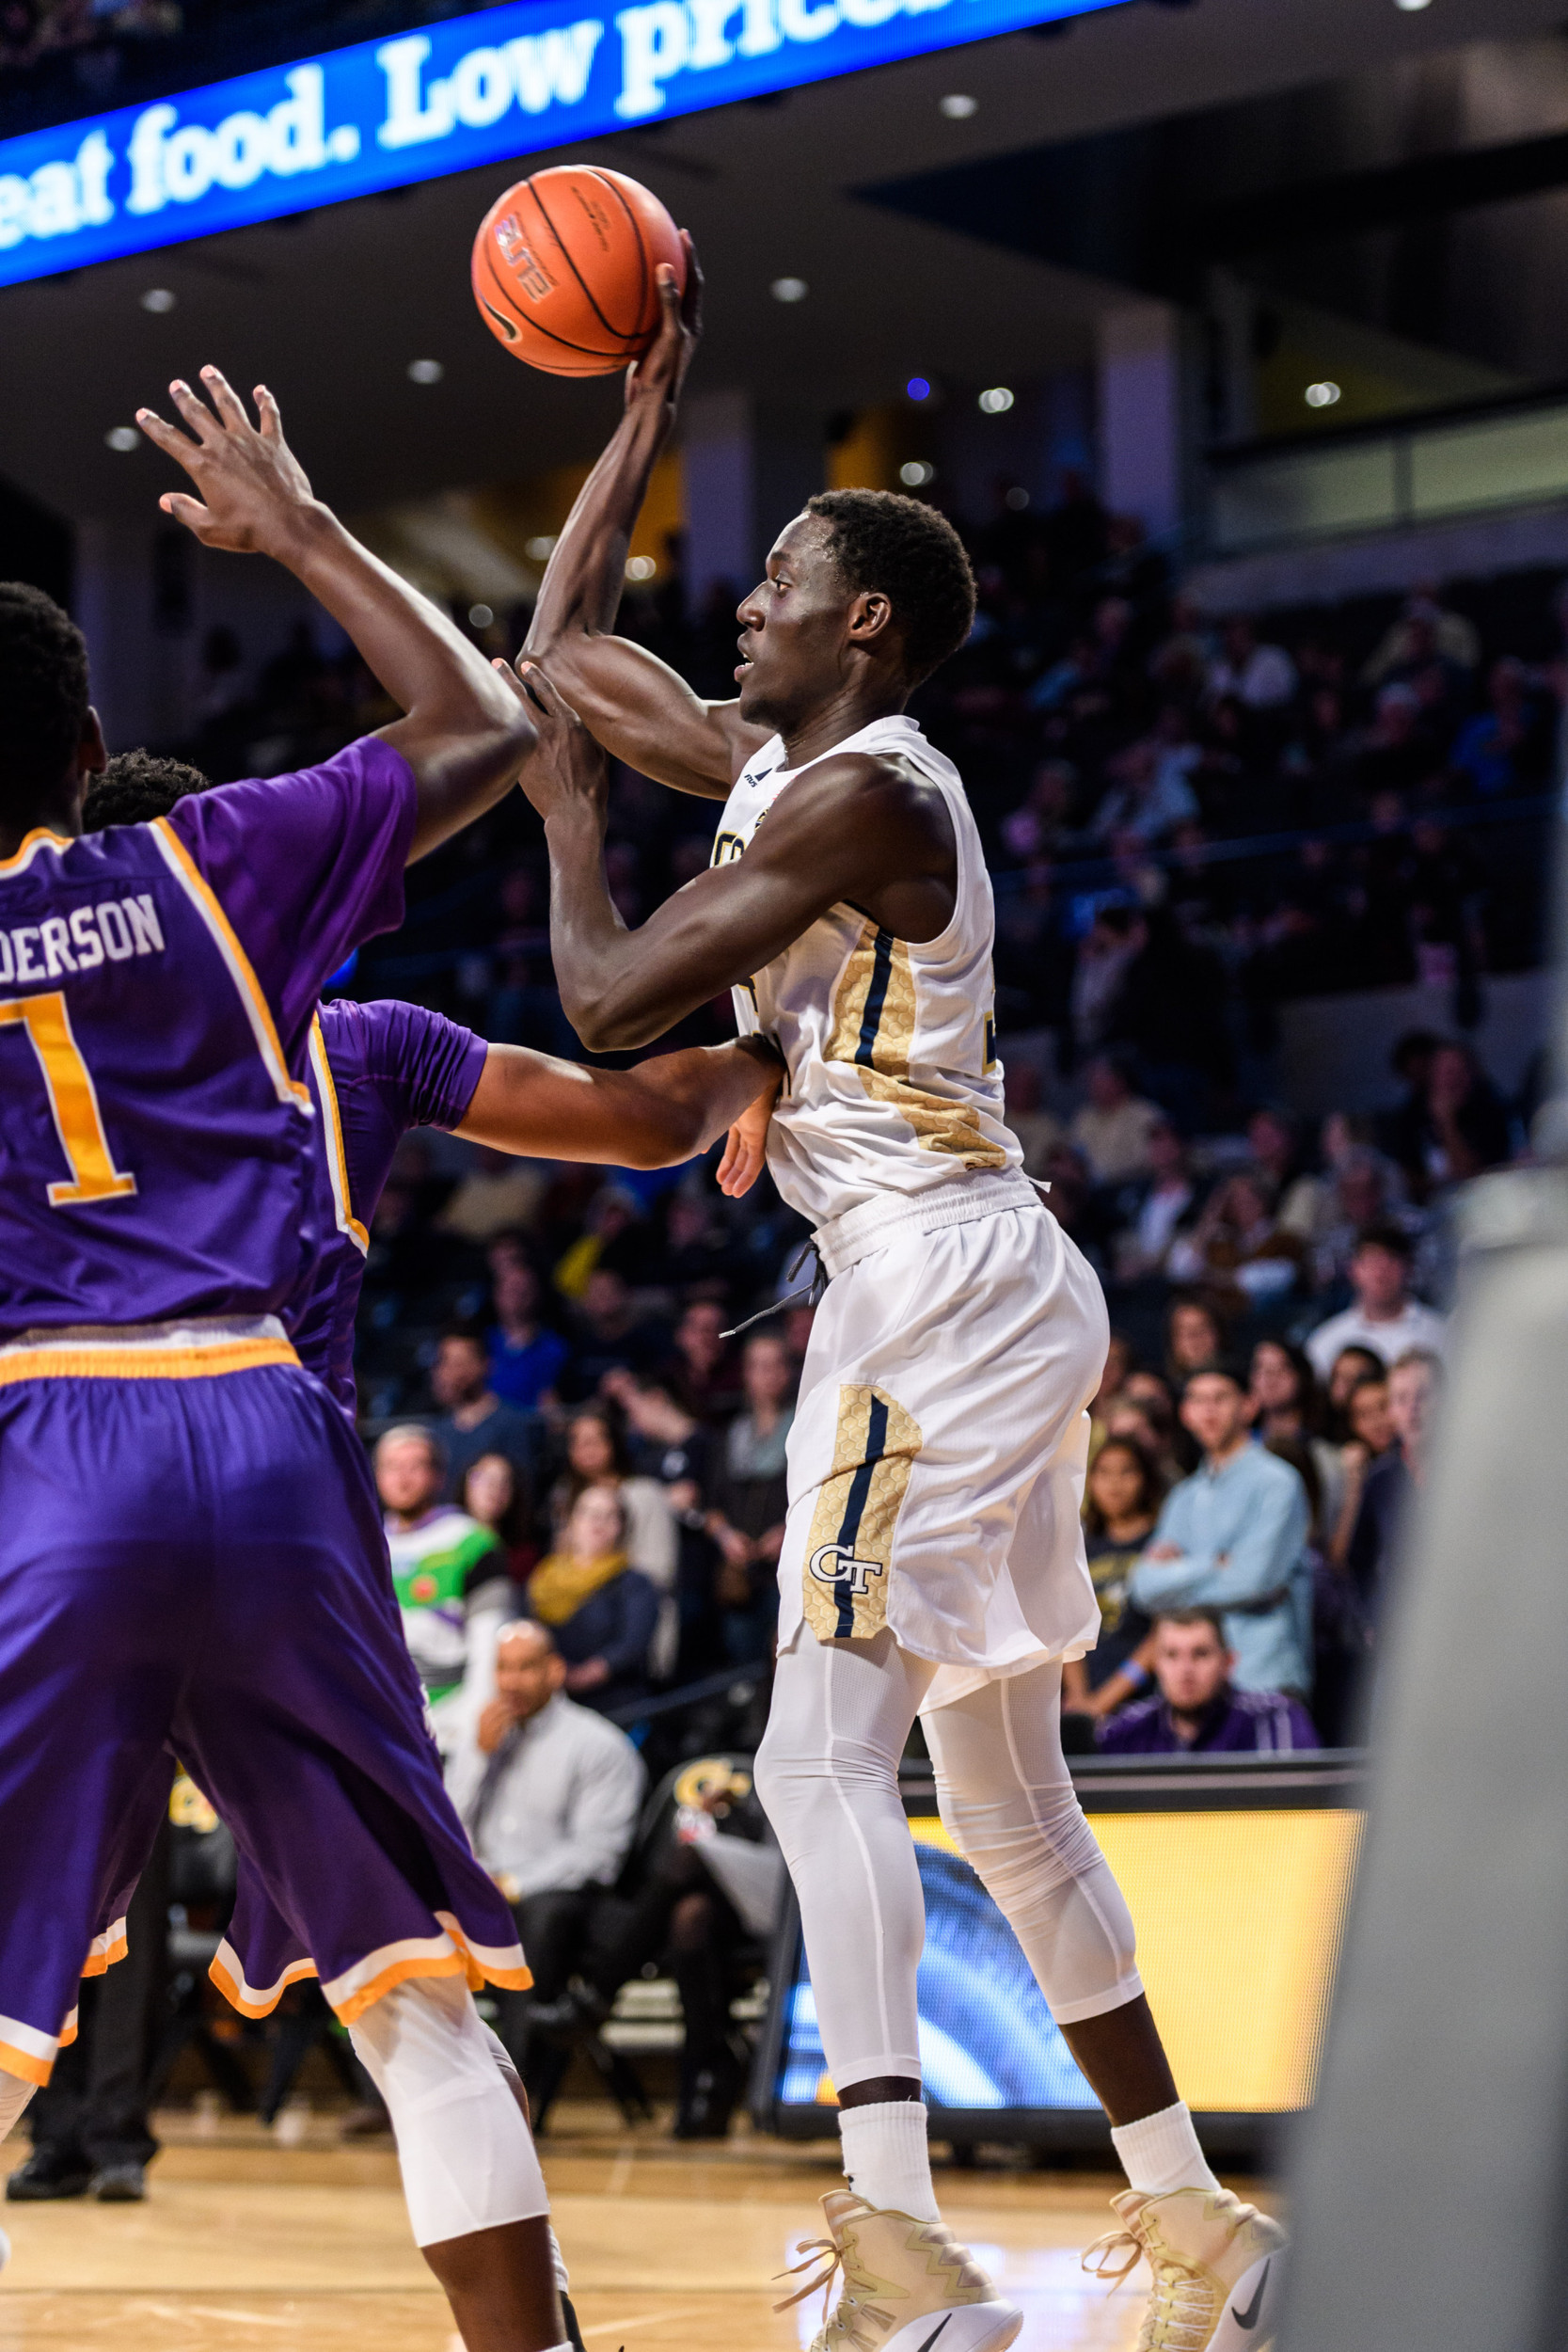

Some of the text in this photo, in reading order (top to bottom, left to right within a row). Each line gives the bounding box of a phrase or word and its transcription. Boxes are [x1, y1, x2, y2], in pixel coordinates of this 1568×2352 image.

[125, 62, 361, 215] food.
[374, 17, 605, 152] Low
[809, 1543, 883, 1595] GT
